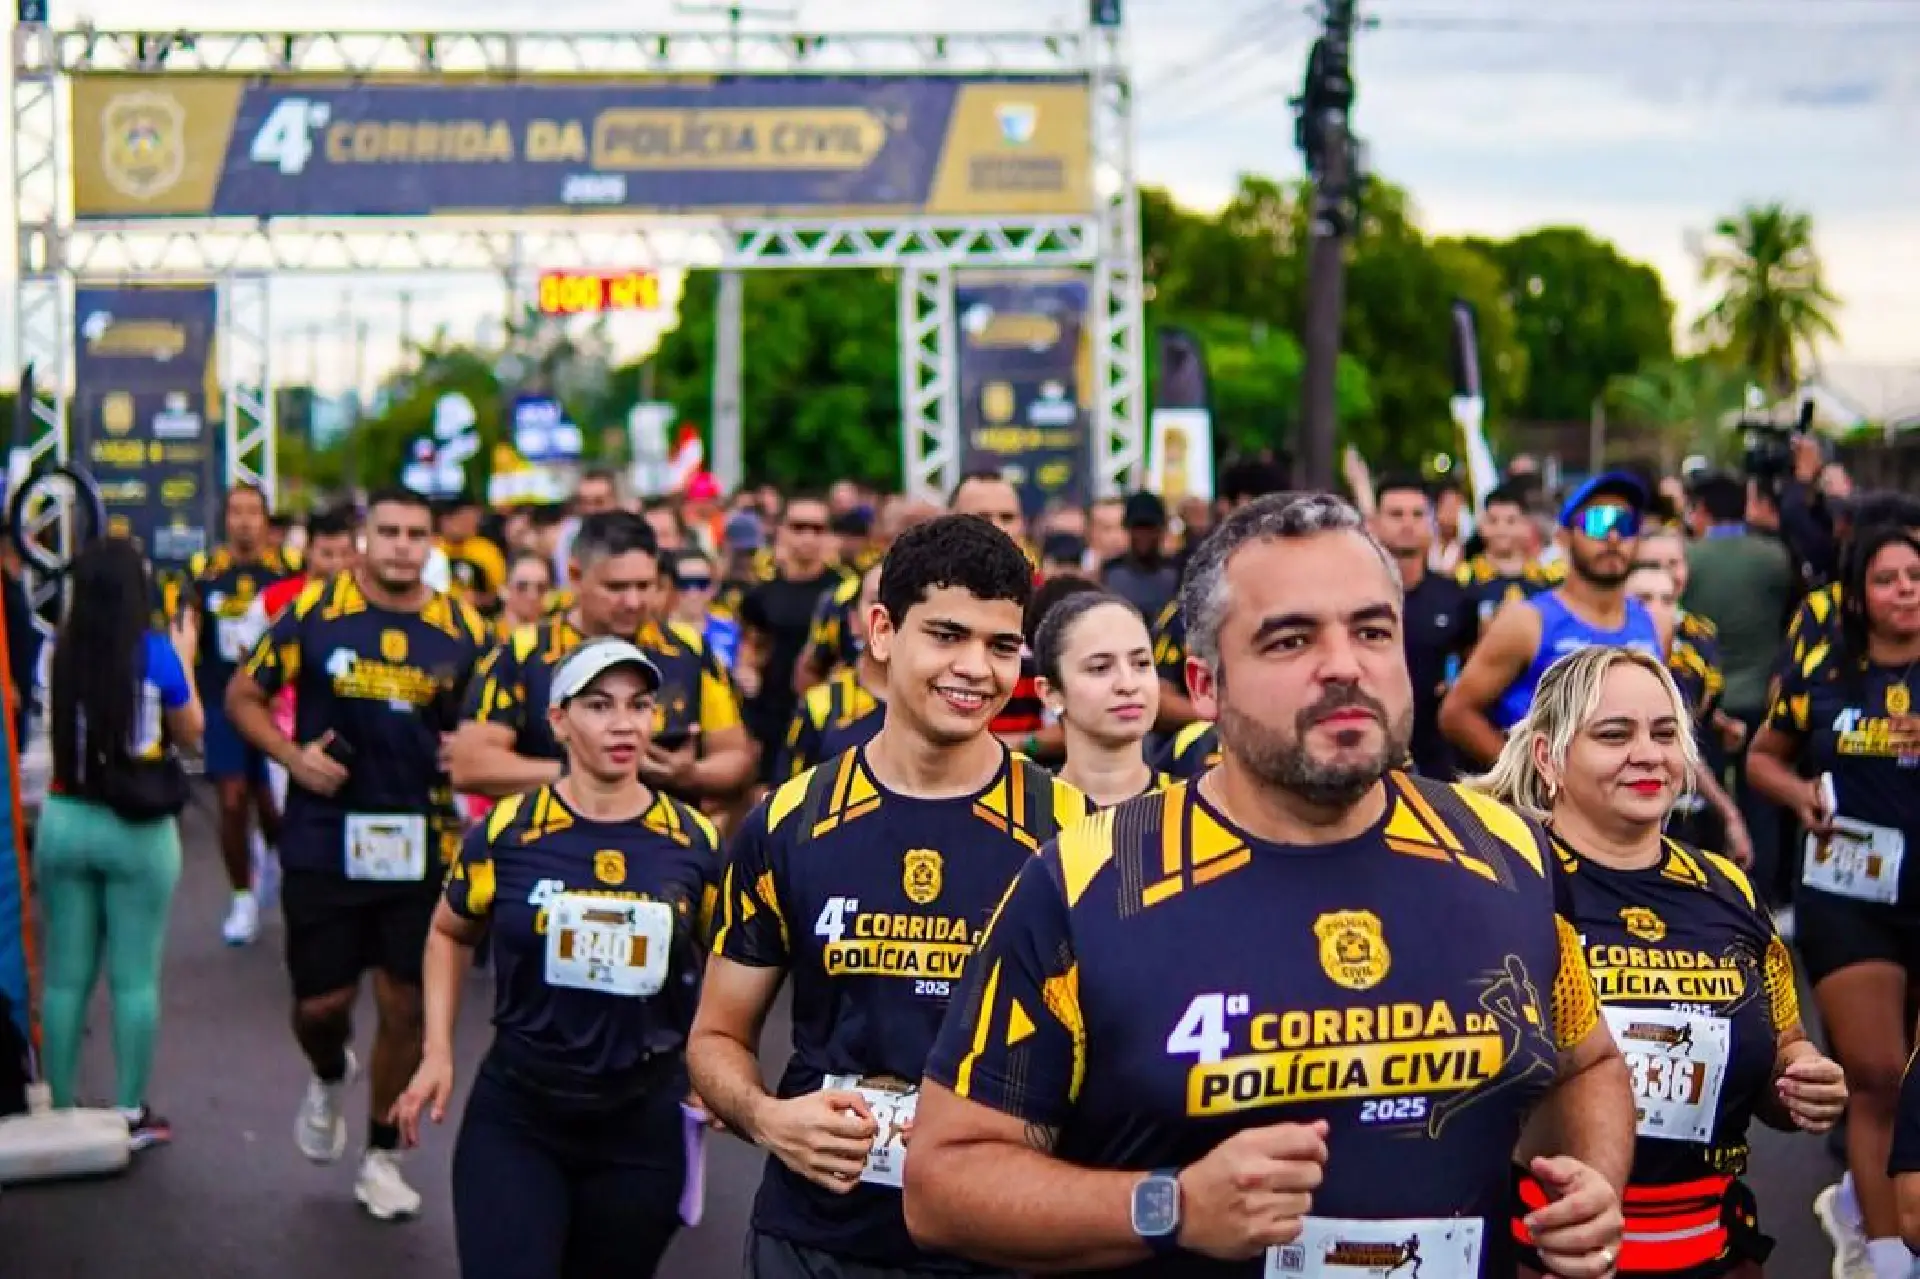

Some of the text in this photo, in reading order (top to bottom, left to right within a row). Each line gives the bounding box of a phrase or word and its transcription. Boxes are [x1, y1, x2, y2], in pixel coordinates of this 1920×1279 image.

[325, 119, 514, 163] CORRIDA
[525, 119, 586, 163] DA
[771, 121, 865, 155] CIVIL
[855, 913, 967, 942] CORRIDA
[828, 942, 967, 974] POLÍCIA CIV
[1589, 944, 1716, 969] CORRIDA
[914, 979, 950, 996] 2025
[1592, 968, 1741, 996] LÍCIA CIVIL
[1249, 1000, 1457, 1051] CORRIDA
[1464, 1012, 1501, 1034] DA
[1200, 1049, 1490, 1109] POLÍCIA CIVIL
[1360, 1097, 1428, 1122] 2025
